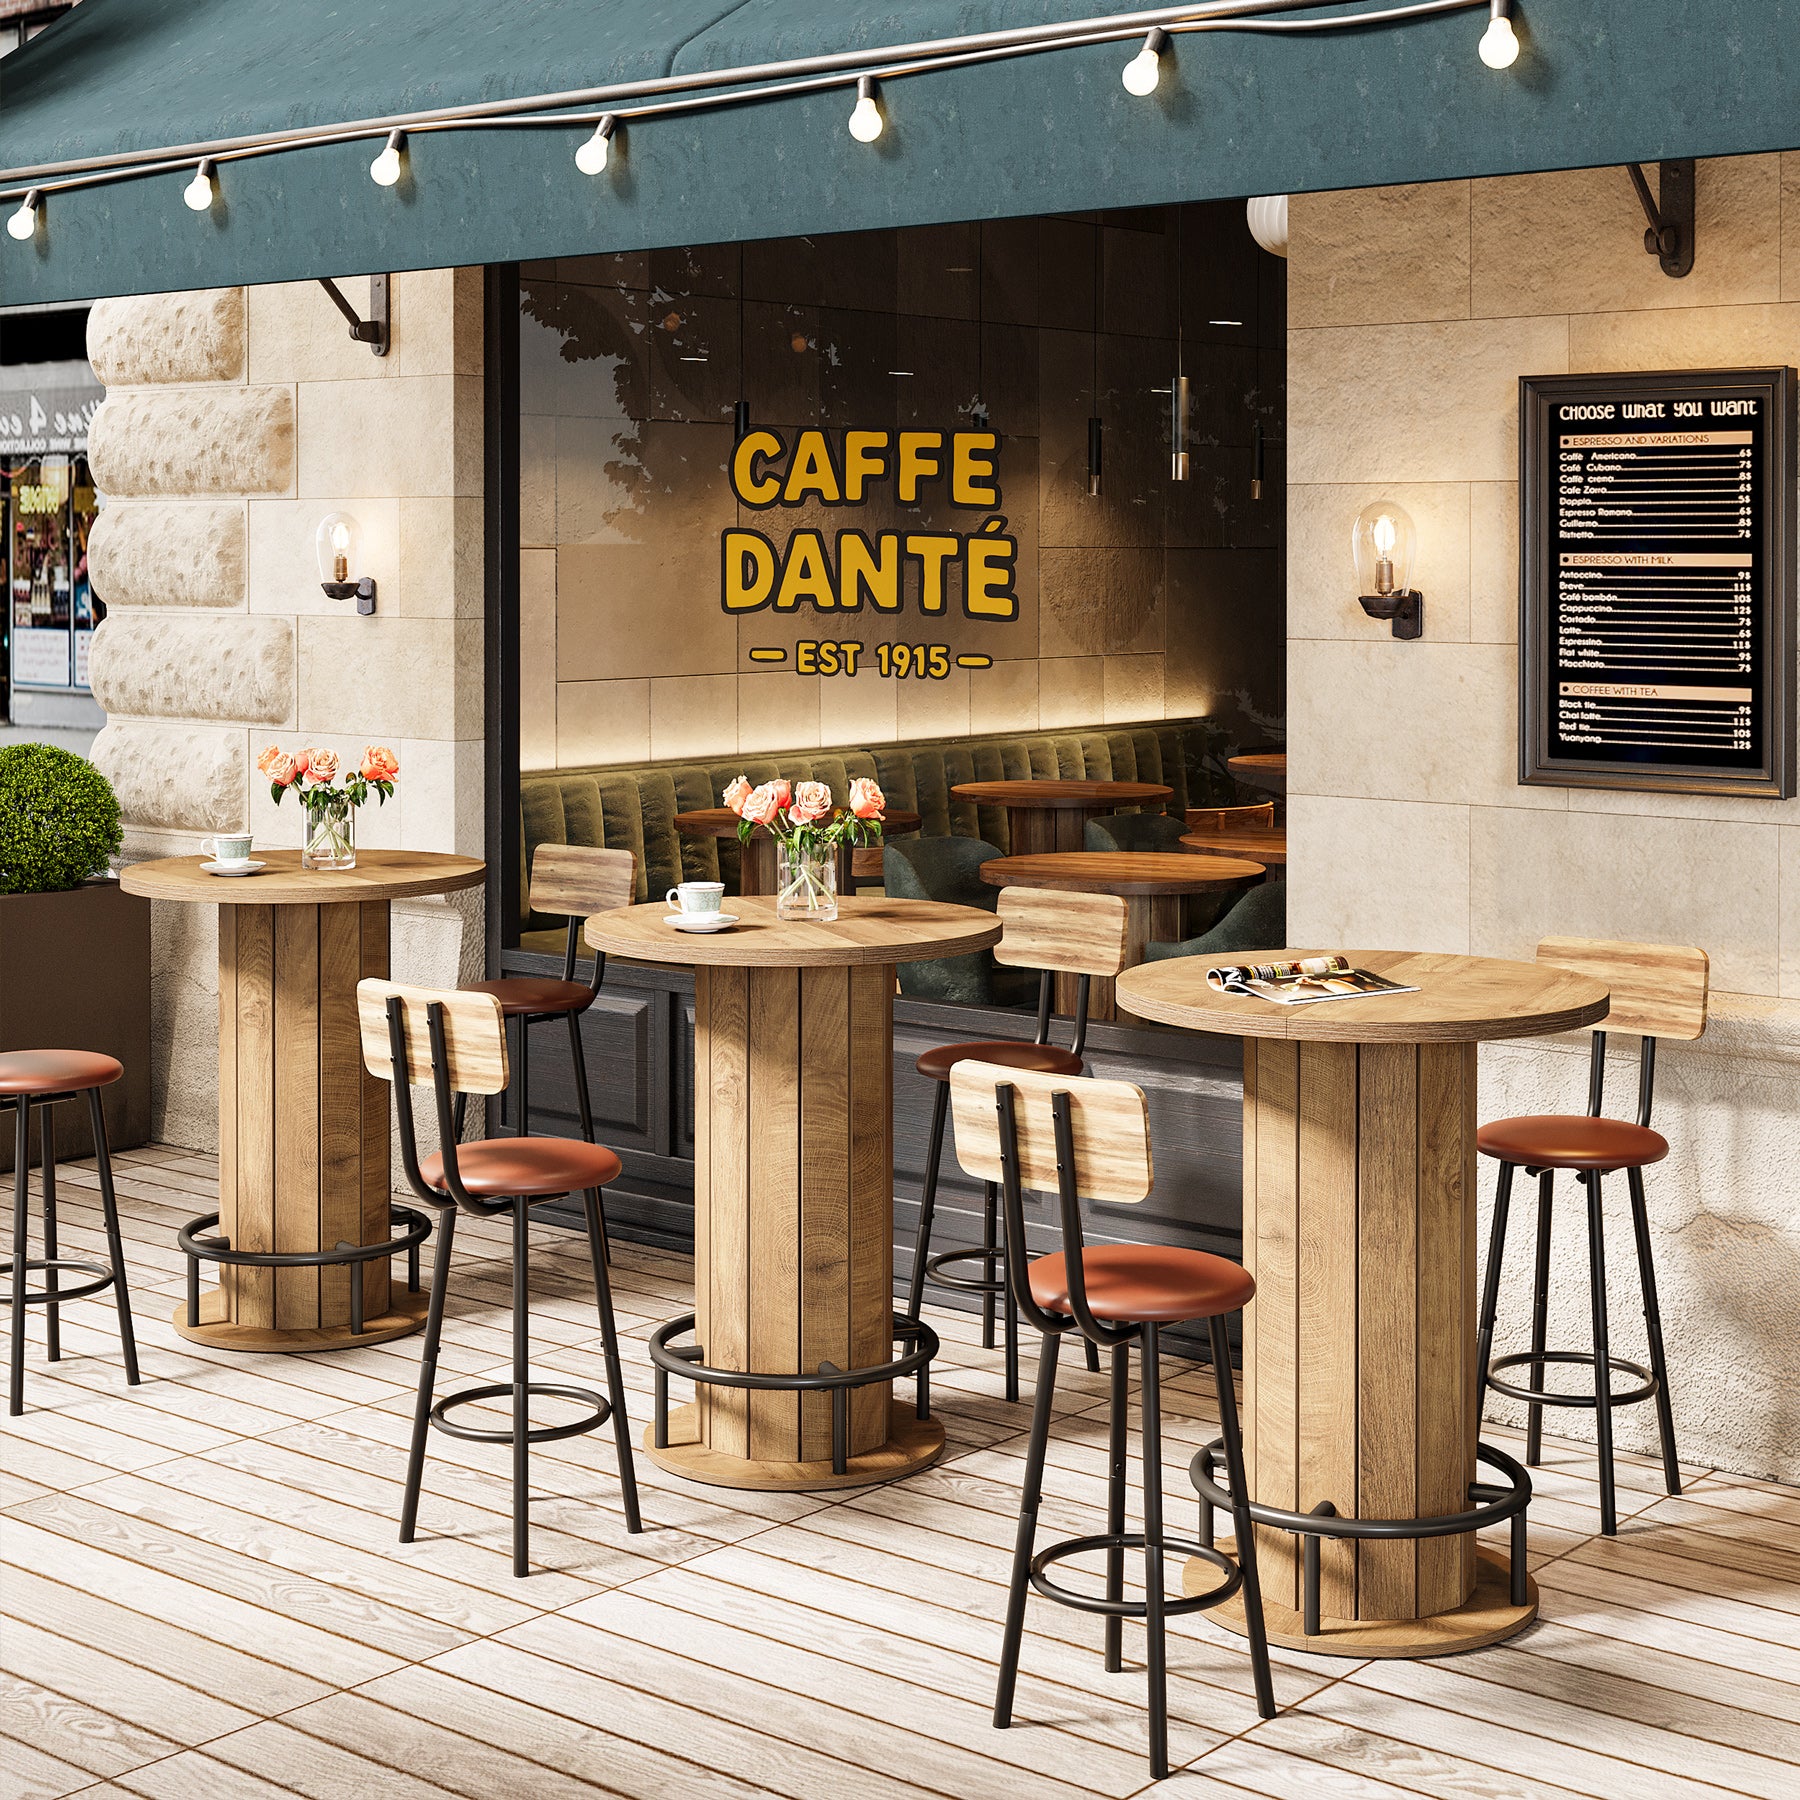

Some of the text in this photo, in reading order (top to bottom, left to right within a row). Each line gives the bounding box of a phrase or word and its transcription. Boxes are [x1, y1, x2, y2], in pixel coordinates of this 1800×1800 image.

[1674, 402, 1703, 417] you
[1711, 400, 1757, 416] want
[1572, 434, 1710, 446] ESPRESSO AND VARIATIONS
[1591, 452, 1637, 460] Americano
[729, 428, 1002, 511] CAFFE
[1586, 463, 1622, 472] Cubano
[1583, 486, 1608, 495] Zorro
[1559, 497, 1592, 507] Doppio
[1559, 508, 1597, 518] Espresso
[1598, 508, 1633, 517] Romano
[1559, 519, 1599, 528] Guillermo
[1559, 530, 1594, 539] Ristretto
[1572, 556, 1675, 565] ESPRESSO WITH MILK
[721, 516, 1018, 622] DANTÉ
[1559, 582, 1584, 590] Breve
[1559, 603, 1613, 613] Cappuccino
[1559, 615, 1597, 624] Cortado
[1559, 626, 1582, 634] Latte
[1559, 648, 1576, 657] Flat
[1577, 649, 1600, 658] white
[796, 641, 951, 680] EST 1915
[1559, 659, 1605, 668] Macchiato
[1572, 685, 1659, 697] COFFEE WITH TEA
[1559, 700, 1583, 709] Black
[1559, 711, 1580, 721] Chai
[1580, 712, 1602, 721] latte
[1559, 722, 1577, 731] Red
[1559, 733, 1602, 744] Yuanyang
